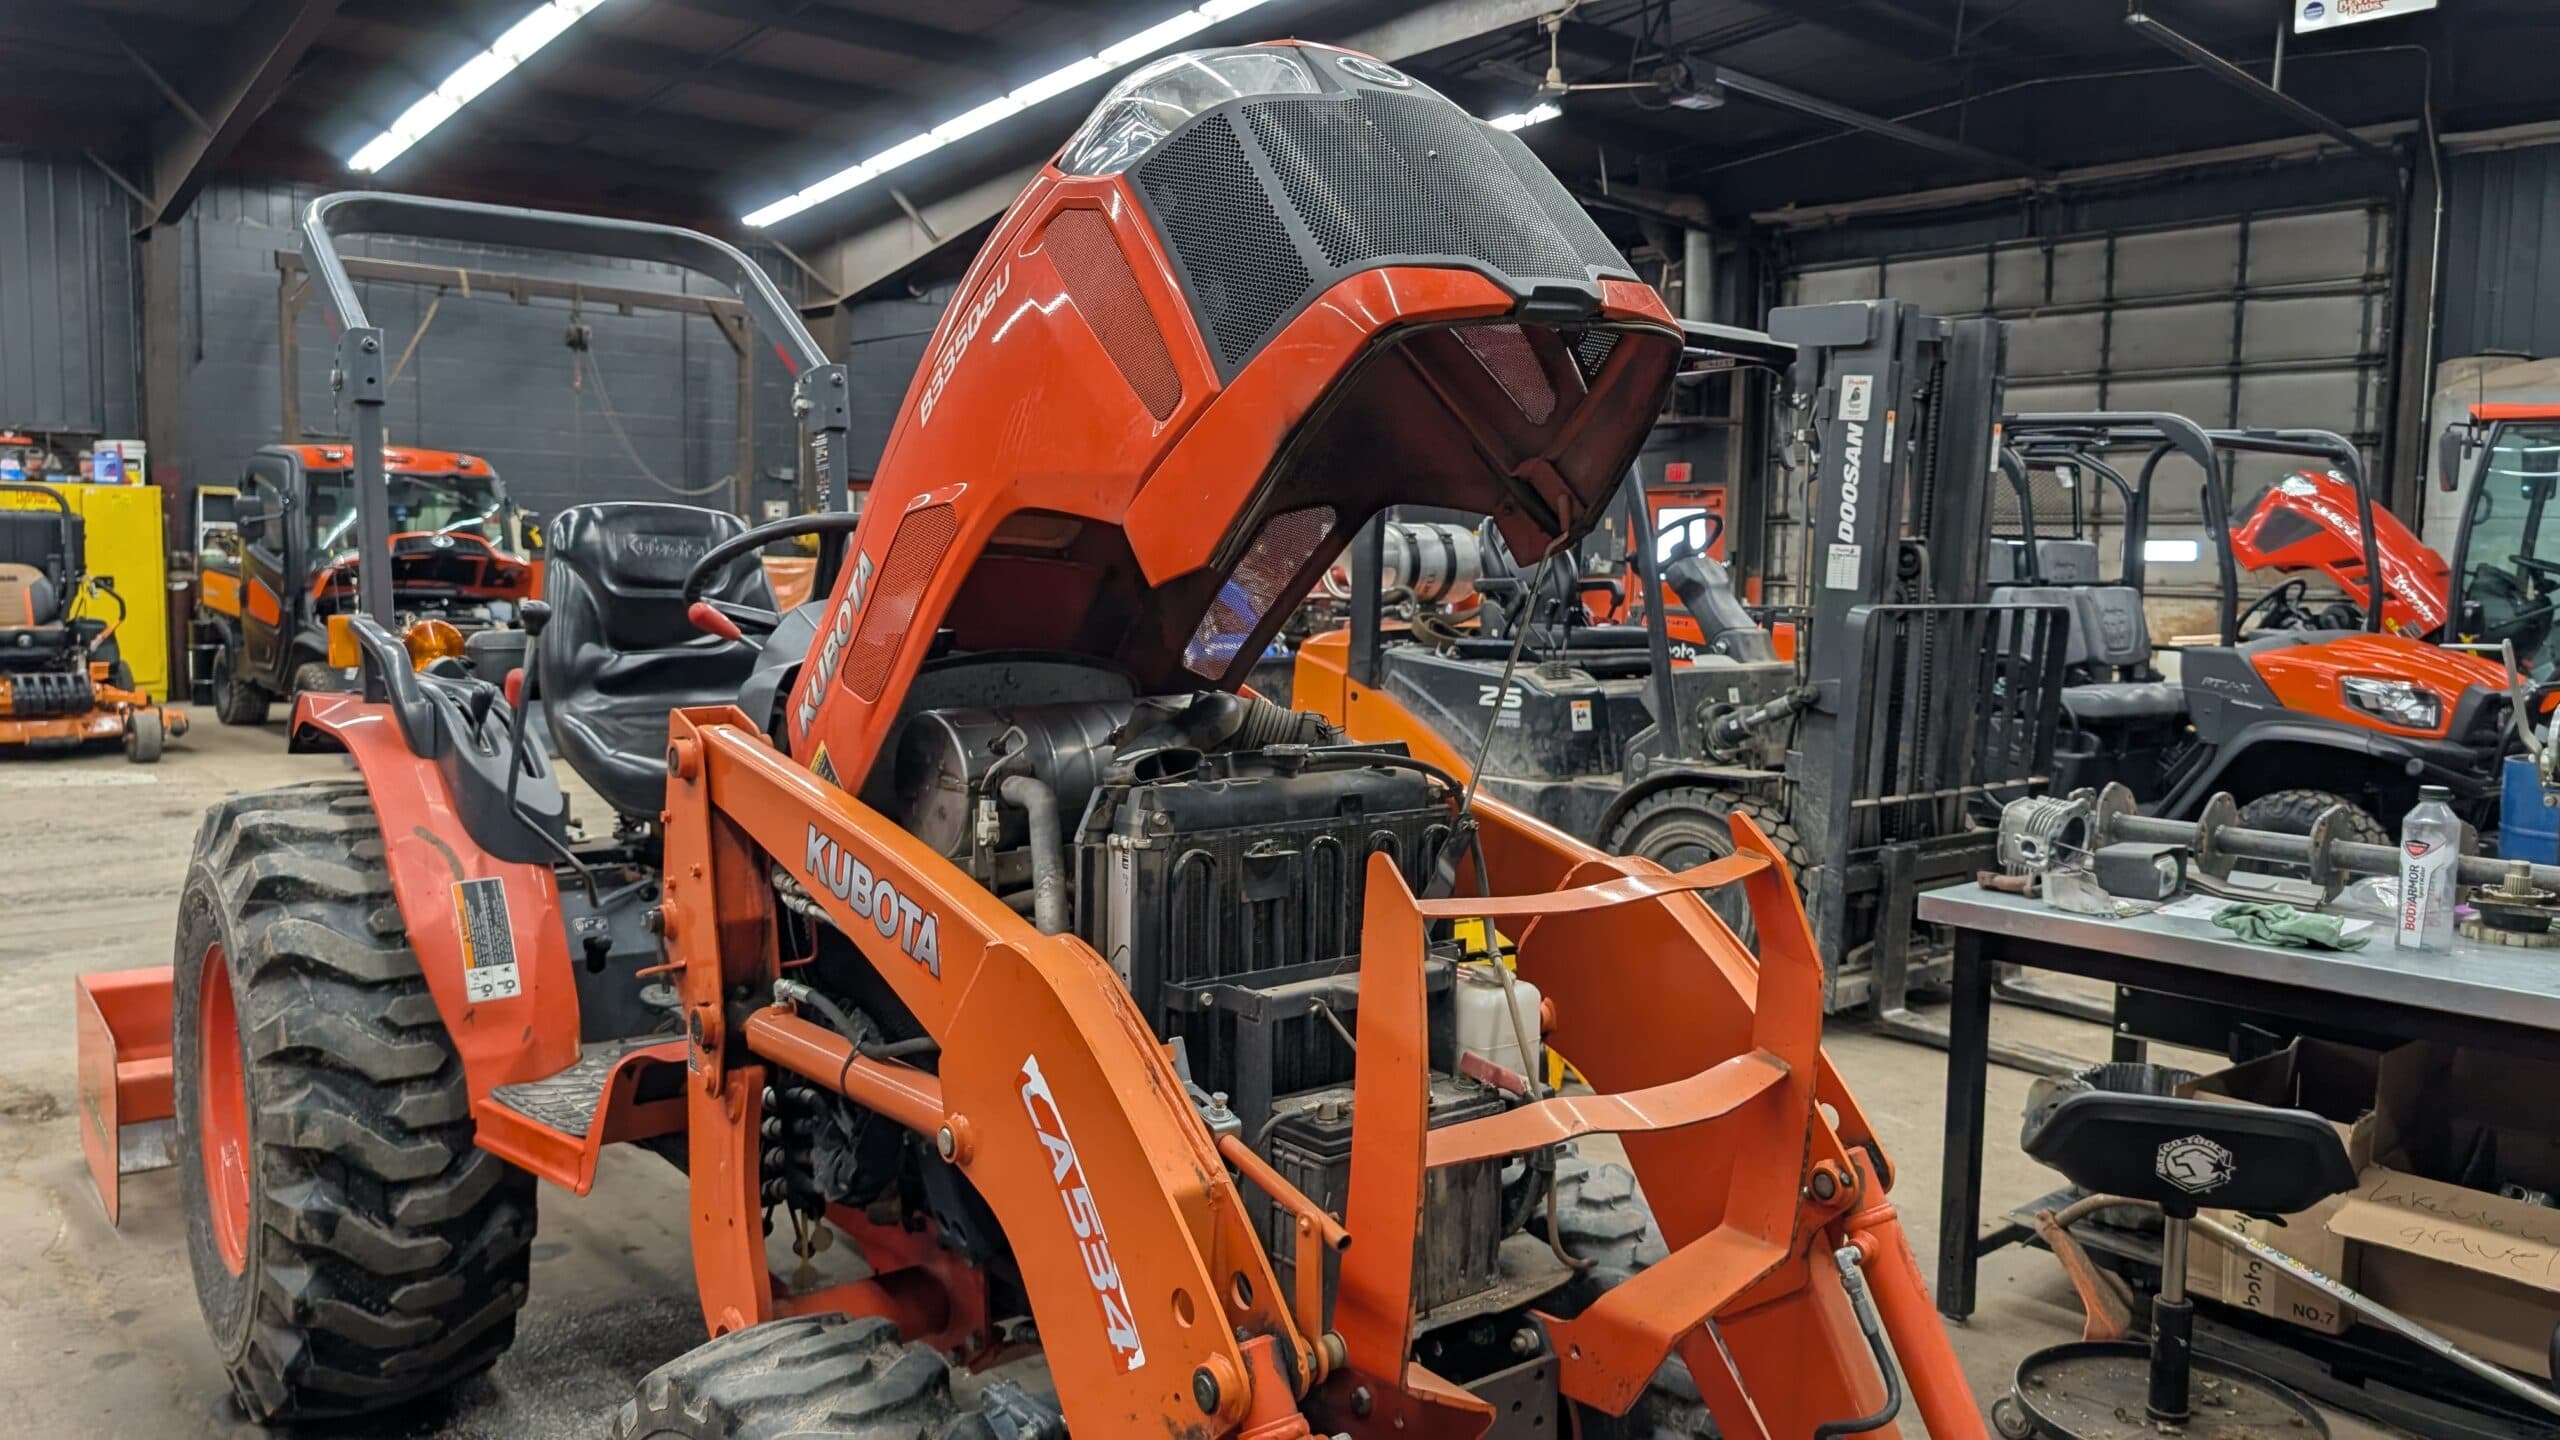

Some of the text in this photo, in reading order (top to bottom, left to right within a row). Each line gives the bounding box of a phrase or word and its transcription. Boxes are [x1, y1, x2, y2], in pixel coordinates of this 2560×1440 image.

[1838, 422, 1864, 544] DOOSAN
[799, 548, 874, 738] KUBOTA
[1669, 643, 1696, 660] ota
[1479, 685, 1522, 708] 25
[805, 822, 942, 981] KUBOTA
[2405, 864, 2420, 931] BODYARMOR
[2243, 1260, 2262, 1307] bota
[2293, 1303, 2335, 1325] NO.7
